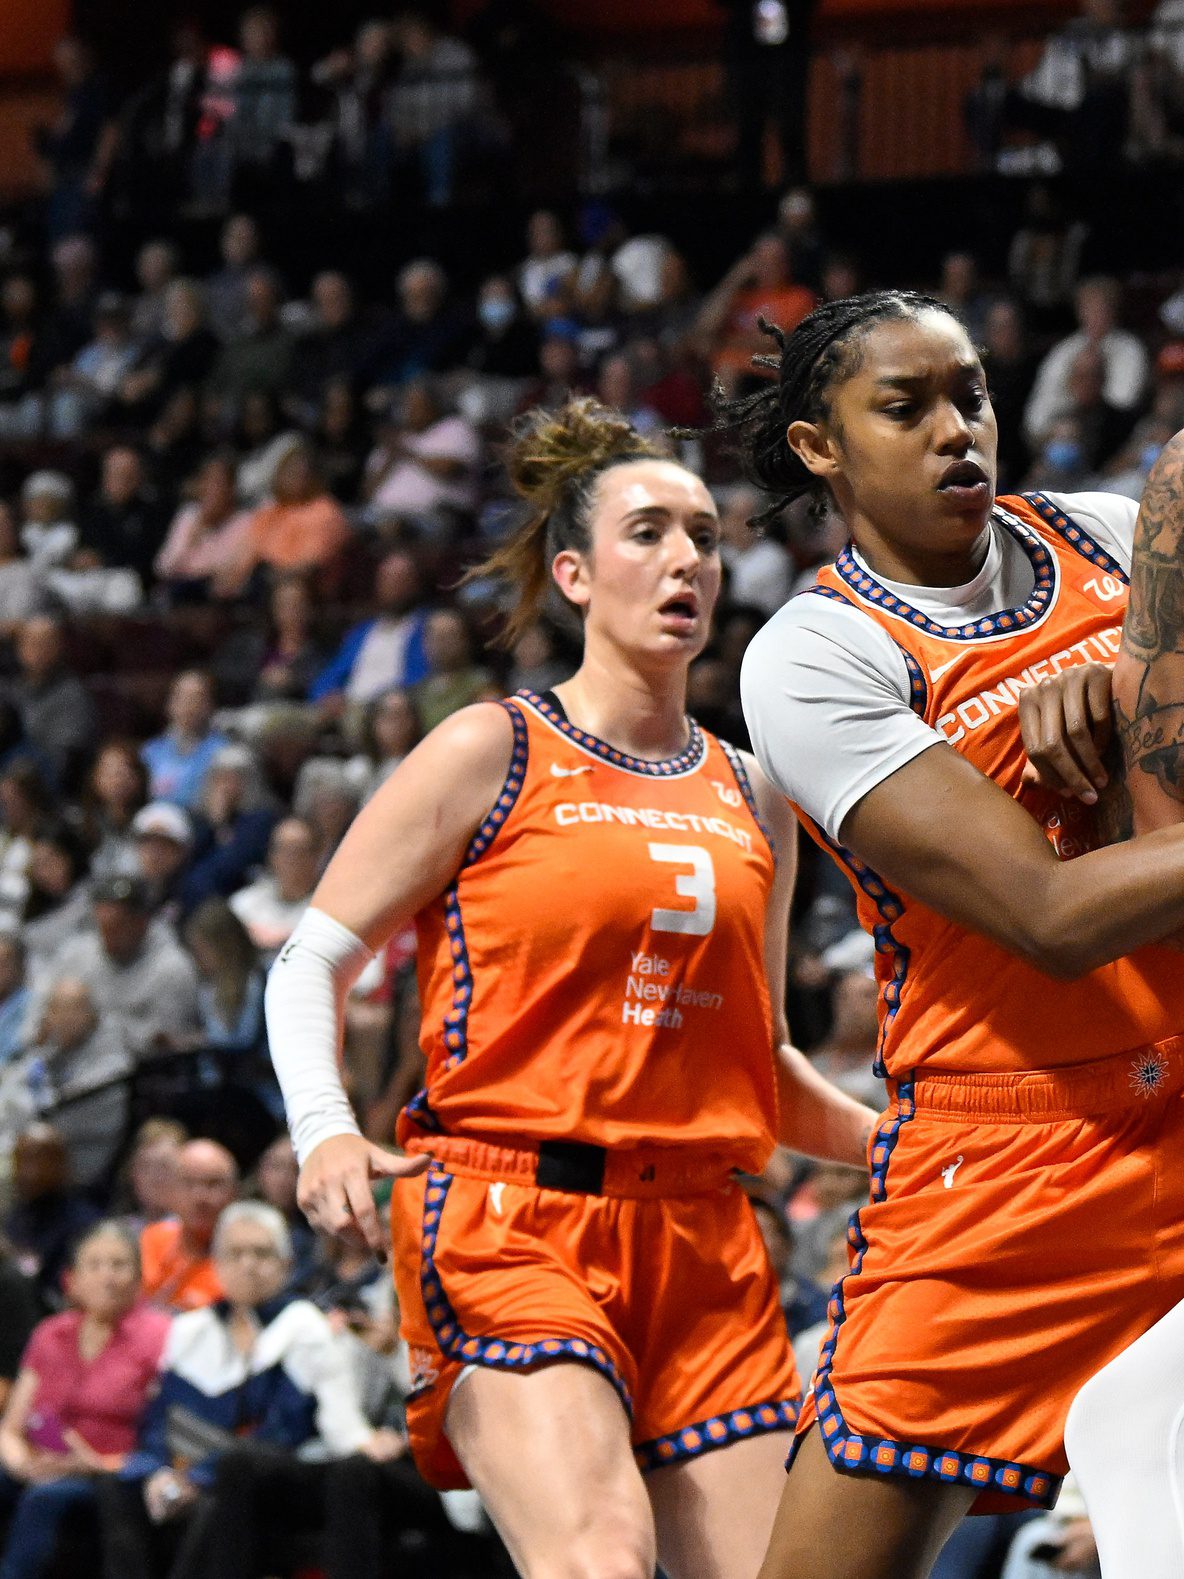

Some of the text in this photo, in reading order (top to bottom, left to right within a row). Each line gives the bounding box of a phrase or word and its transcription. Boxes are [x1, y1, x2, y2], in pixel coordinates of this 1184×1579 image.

[934, 626, 1123, 746] CONNECTIC
[555, 802, 752, 853] CONNECTICUT
[648, 842, 716, 936] 3
[630, 951, 671, 977] Yale
